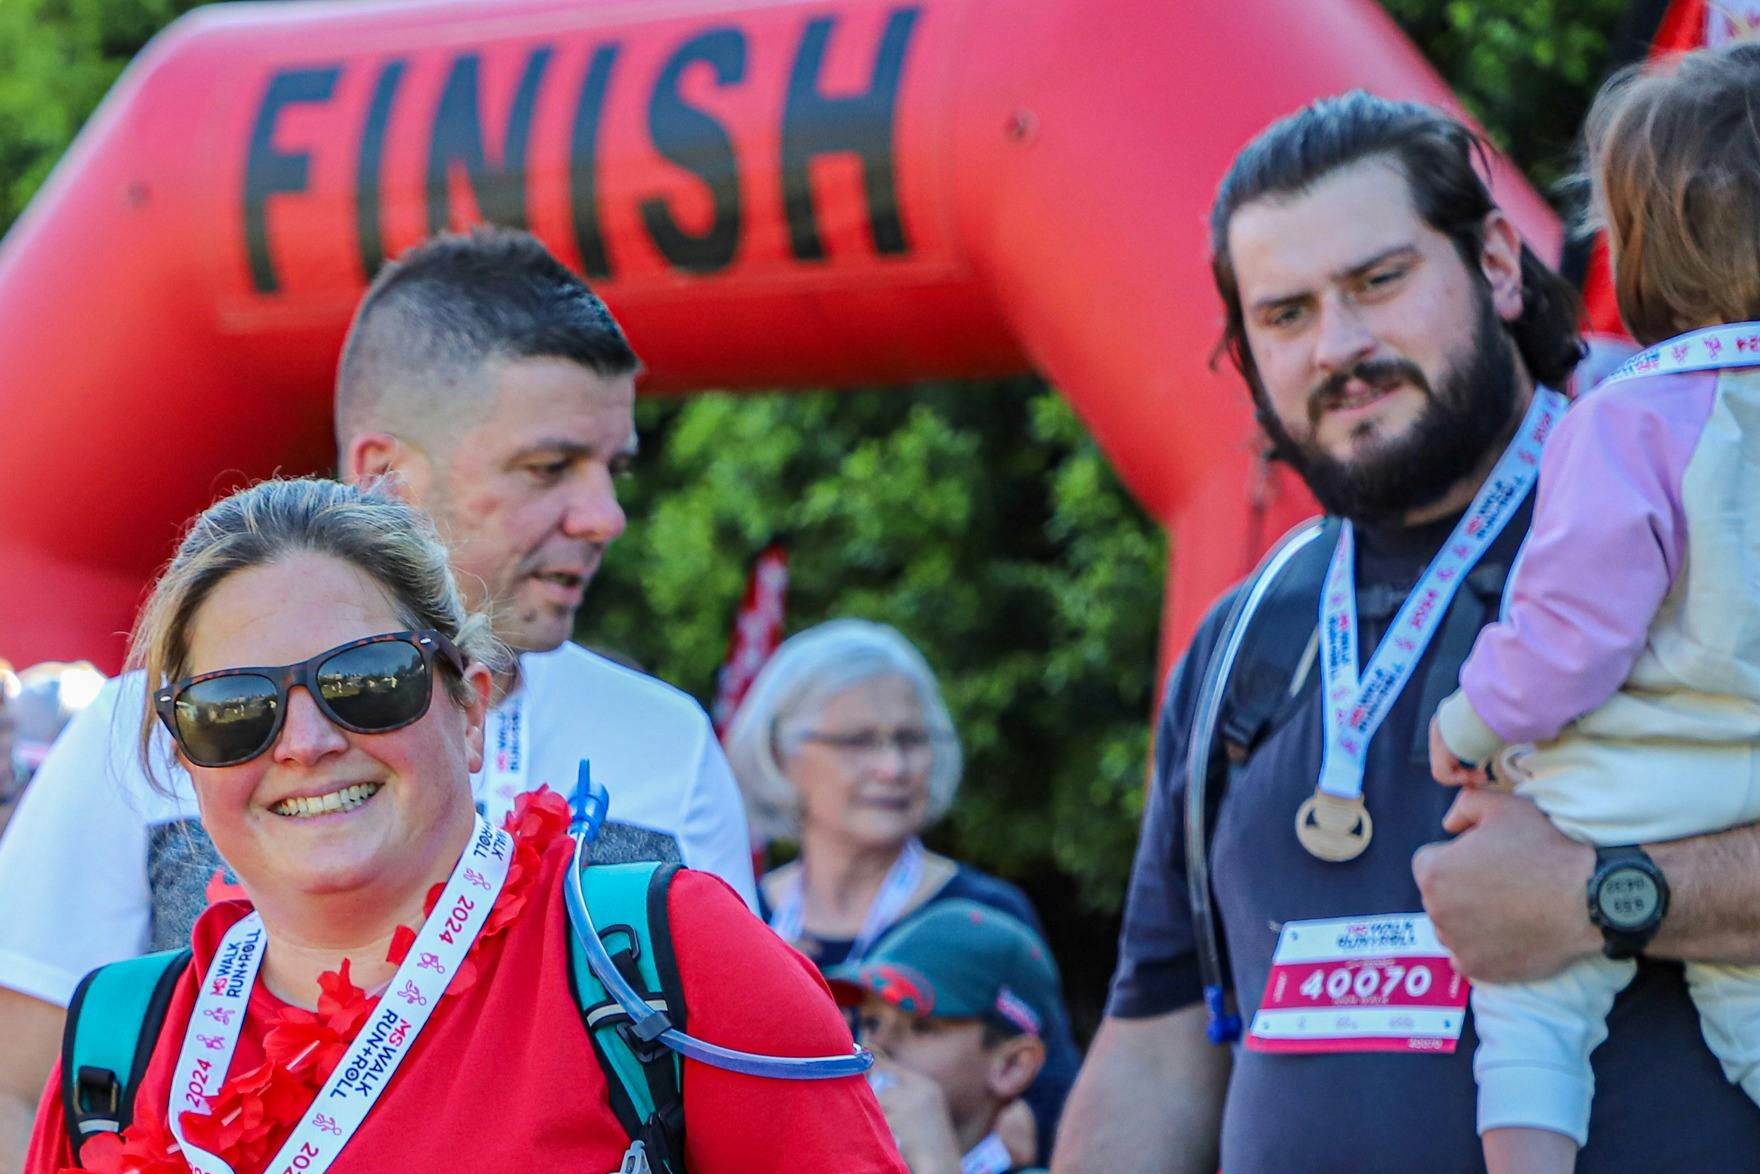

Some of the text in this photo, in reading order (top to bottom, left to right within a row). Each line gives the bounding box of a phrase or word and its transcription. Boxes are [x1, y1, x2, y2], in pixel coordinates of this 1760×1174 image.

[242, 4, 924, 294] FINISH
[438, 895, 474, 946] 2024
[226, 928, 262, 998] RUN+ROLL
[1300, 965, 1433, 1000] 40070
[186, 1057, 212, 1108] 2024
[330, 1008, 399, 1099] RUN+ROLL
